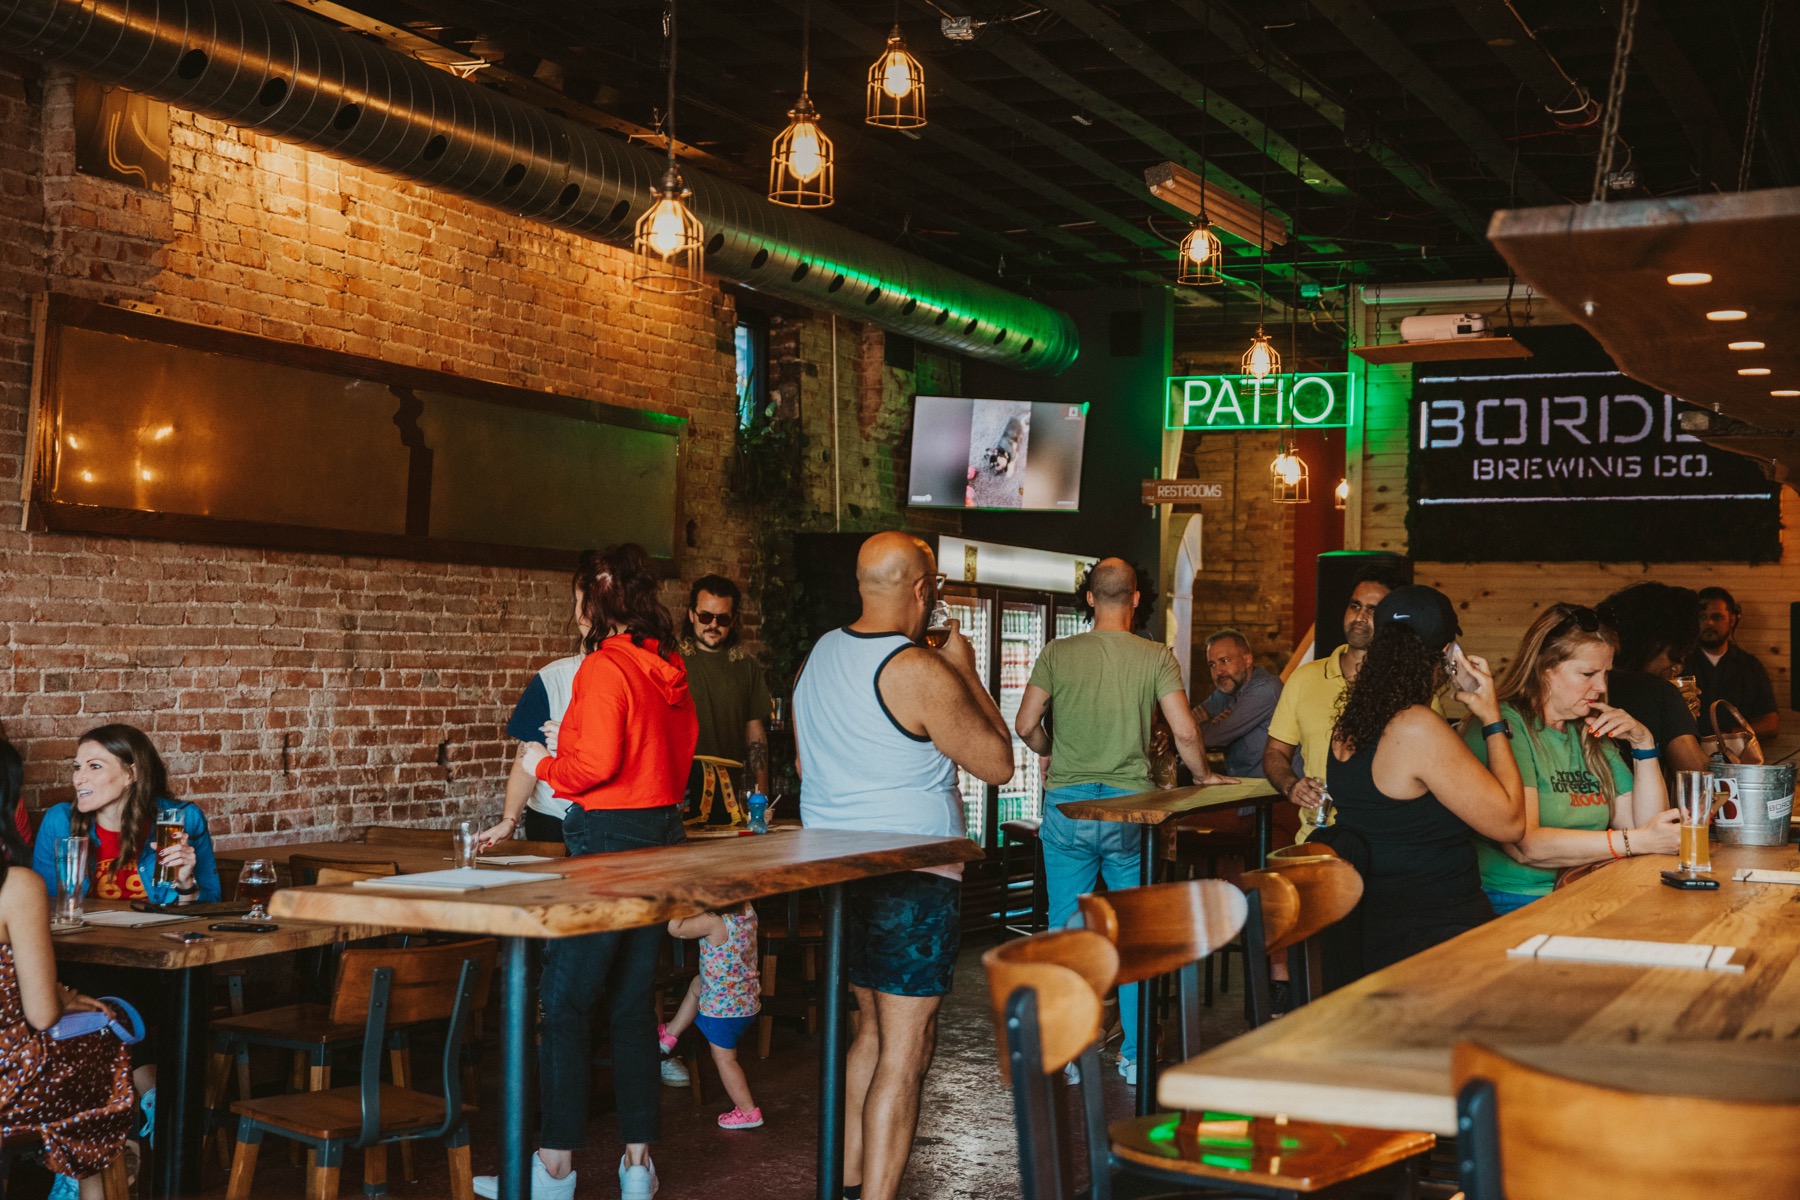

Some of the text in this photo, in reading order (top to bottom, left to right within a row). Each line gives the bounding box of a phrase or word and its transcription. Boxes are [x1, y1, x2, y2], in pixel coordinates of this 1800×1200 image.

[1183, 376, 1335, 425] PATIO
[1419, 394, 1703, 449] BORDE
[1473, 454, 1713, 481] BREWING CO.
[1157, 484, 1222, 498] RESTROOMS
[1769, 800, 1791, 812] BORD
